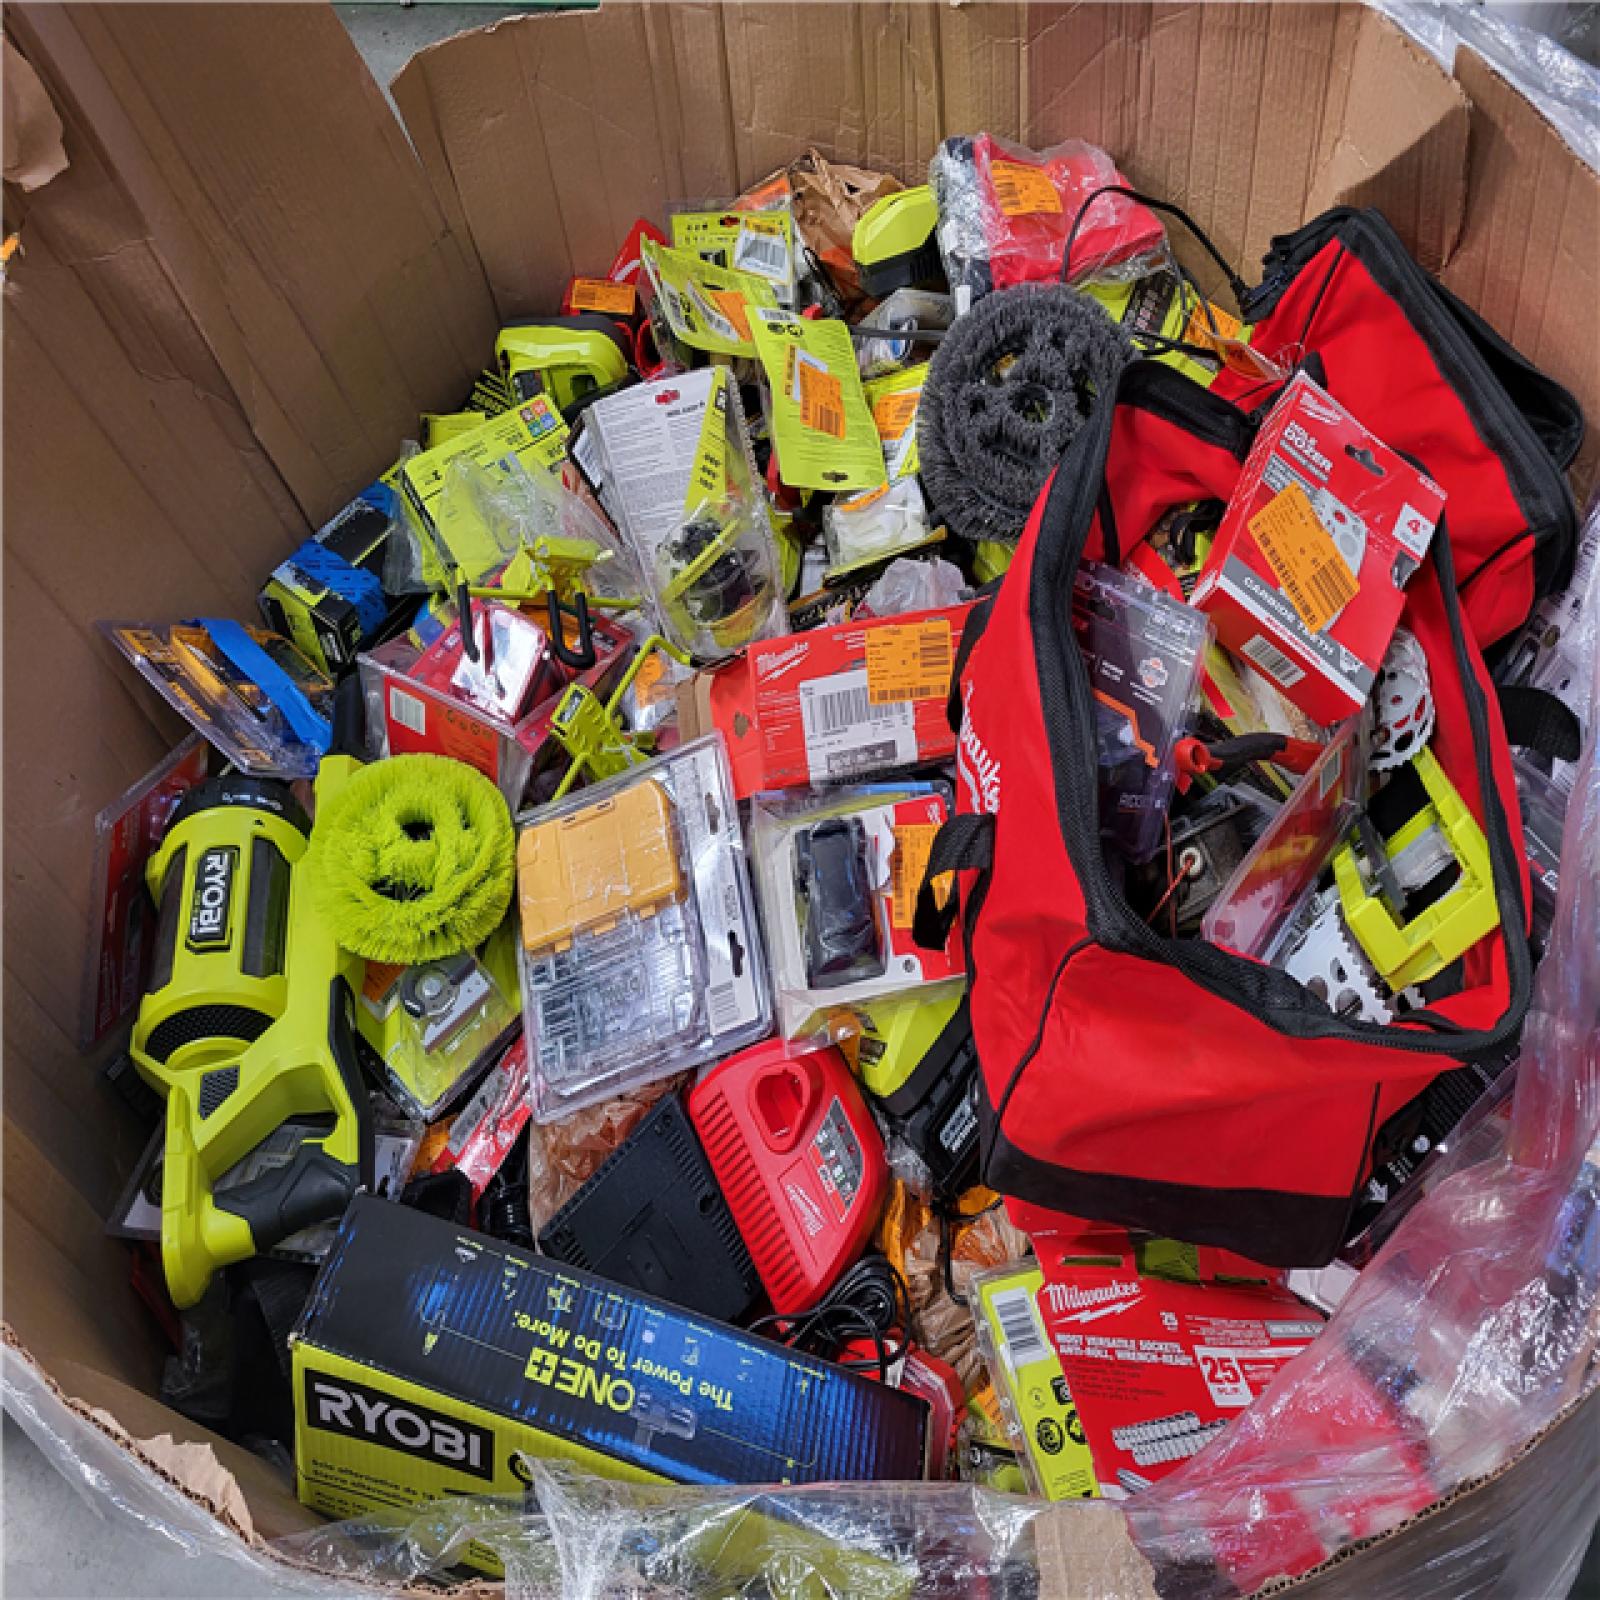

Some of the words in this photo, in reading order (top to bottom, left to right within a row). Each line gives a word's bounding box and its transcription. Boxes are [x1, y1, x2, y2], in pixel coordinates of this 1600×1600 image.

[199, 853, 229, 934] RYOBI
[1041, 1280, 1140, 1314] Milwaukee
[573, 1334, 601, 1360] Do
[606, 1346, 627, 1371] To
[631, 1357, 694, 1396] Power
[1202, 1356, 1240, 1384] 25
[698, 1381, 734, 1411] The
[314, 1382, 482, 1469] RYOBI
